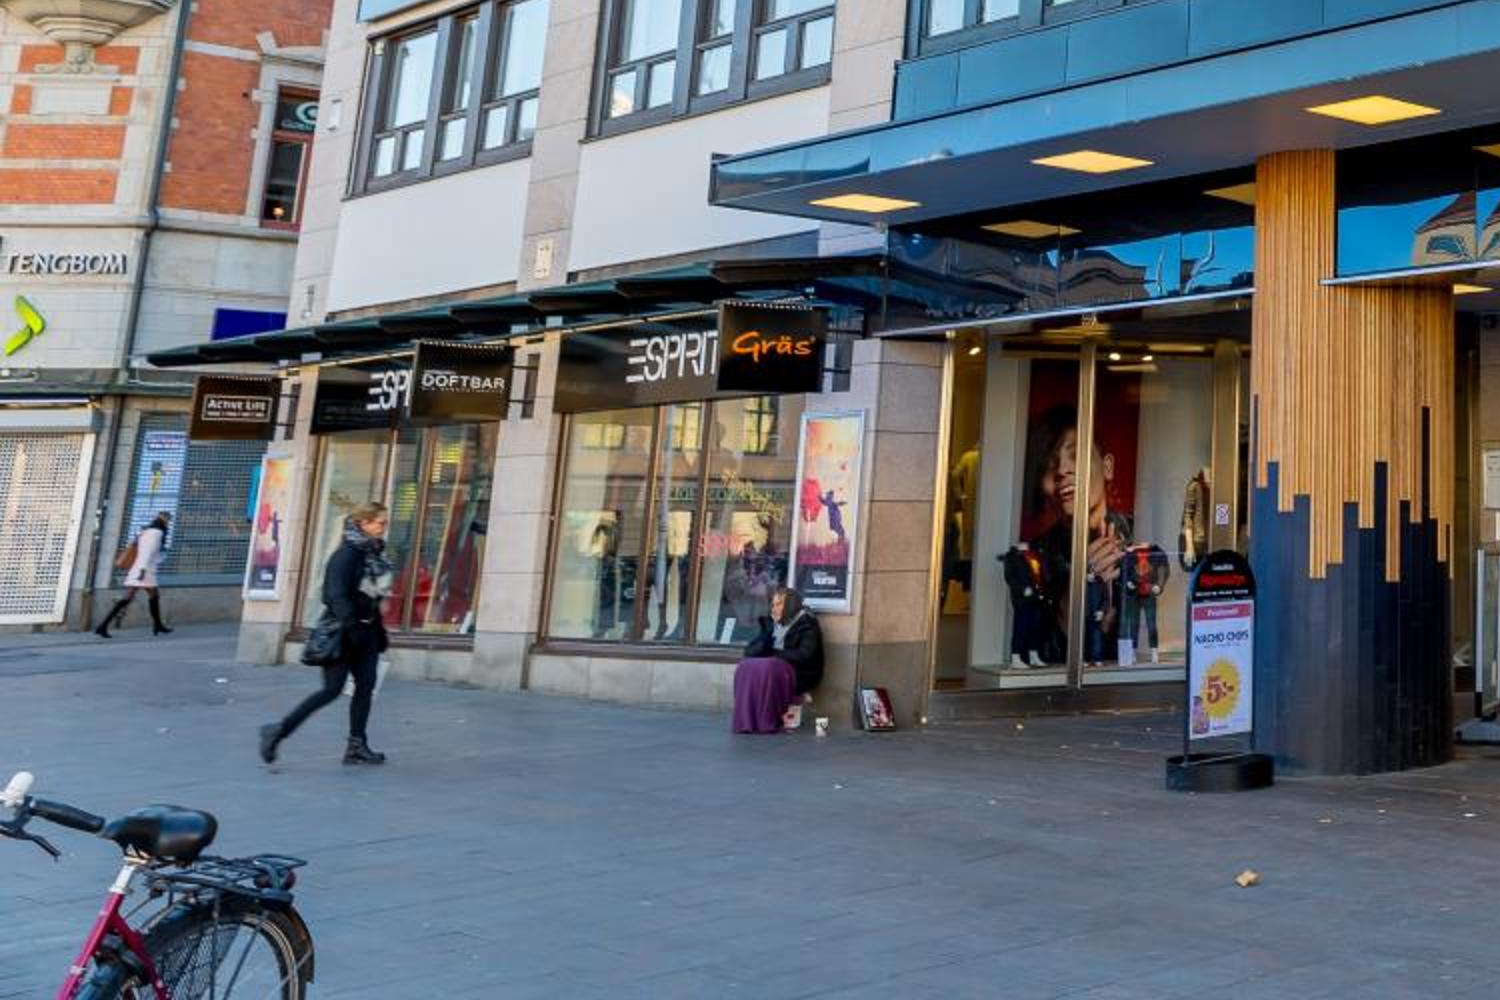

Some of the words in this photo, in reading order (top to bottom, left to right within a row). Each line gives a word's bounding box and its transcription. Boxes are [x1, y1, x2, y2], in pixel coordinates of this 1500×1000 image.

[7, 253, 128, 275] TENGBOM
[732, 331, 812, 364] Gräs
[421, 372, 506, 390] DOFTBAR
